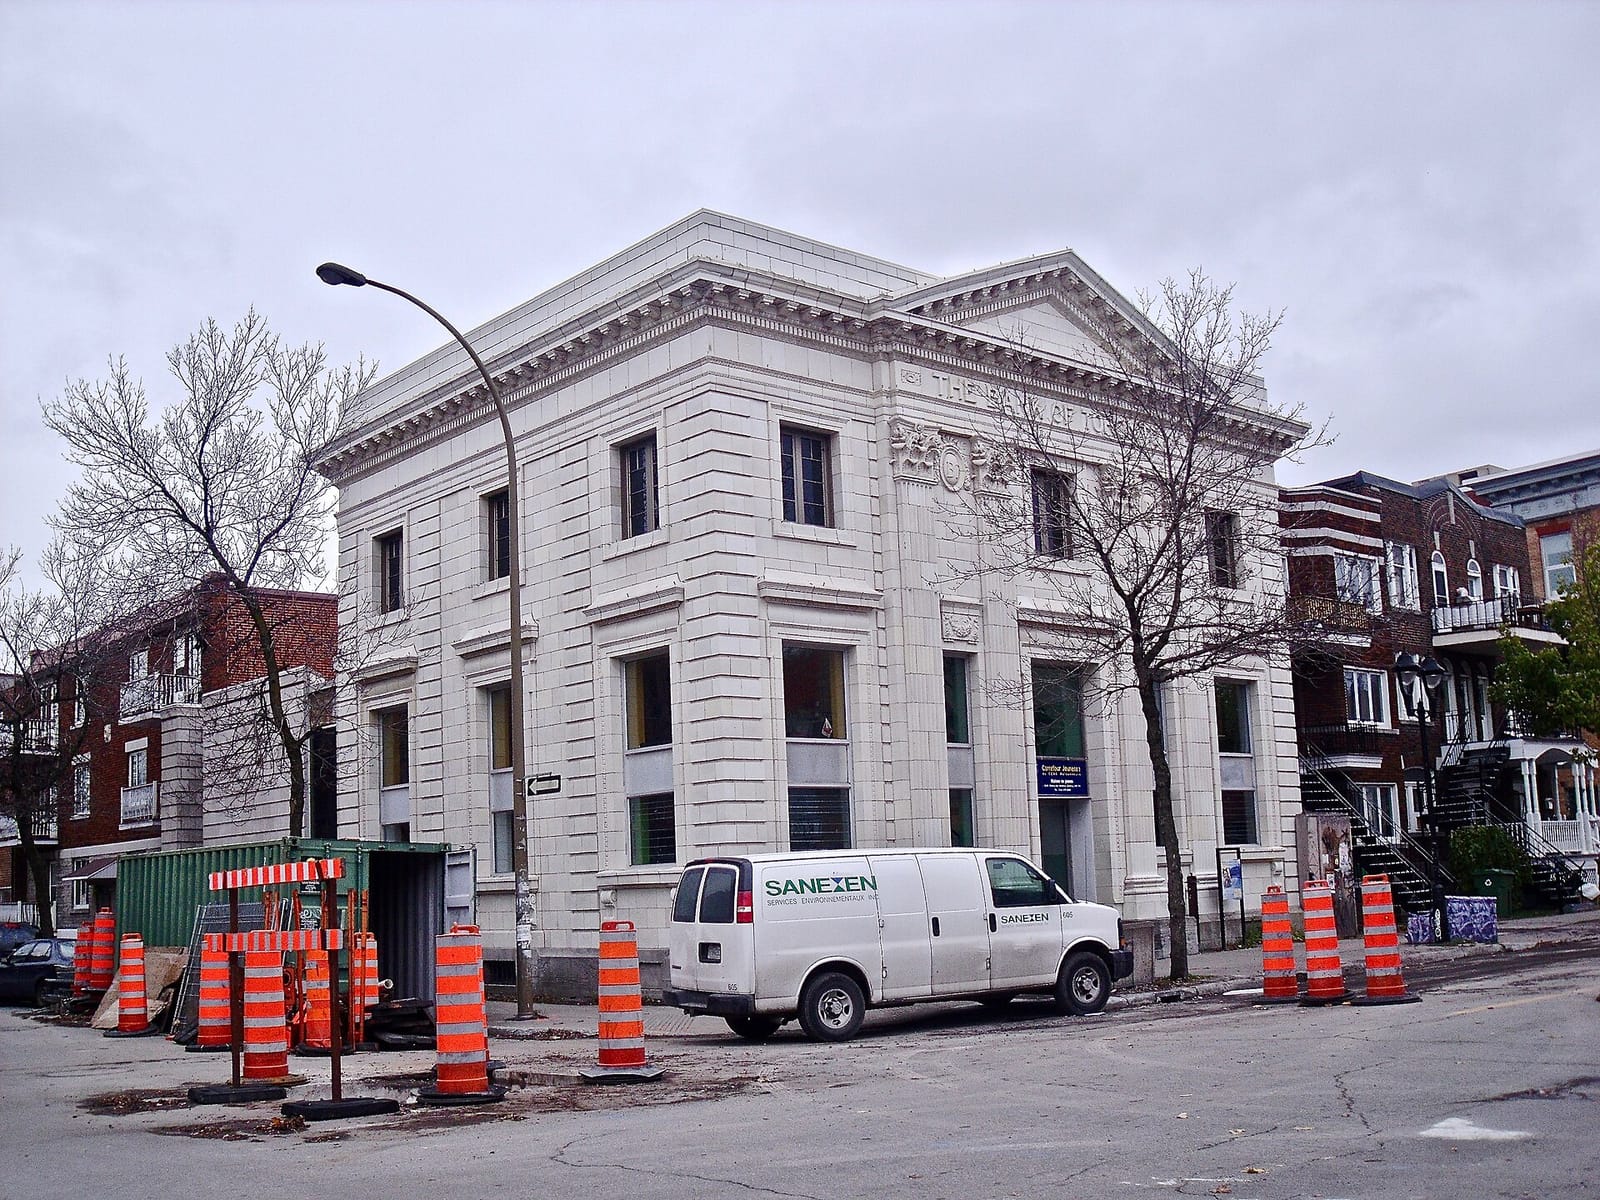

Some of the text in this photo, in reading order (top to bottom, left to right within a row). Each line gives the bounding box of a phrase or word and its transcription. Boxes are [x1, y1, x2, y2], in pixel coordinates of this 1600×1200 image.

[932, 375, 977, 404] THE
[765, 875, 878, 896] SANEXEN
[767, 898, 798, 907] SERVICES
[801, 895, 865, 905] ENVIRONNEMENTAUX
[1000, 912, 1049, 924] SANEXEN
